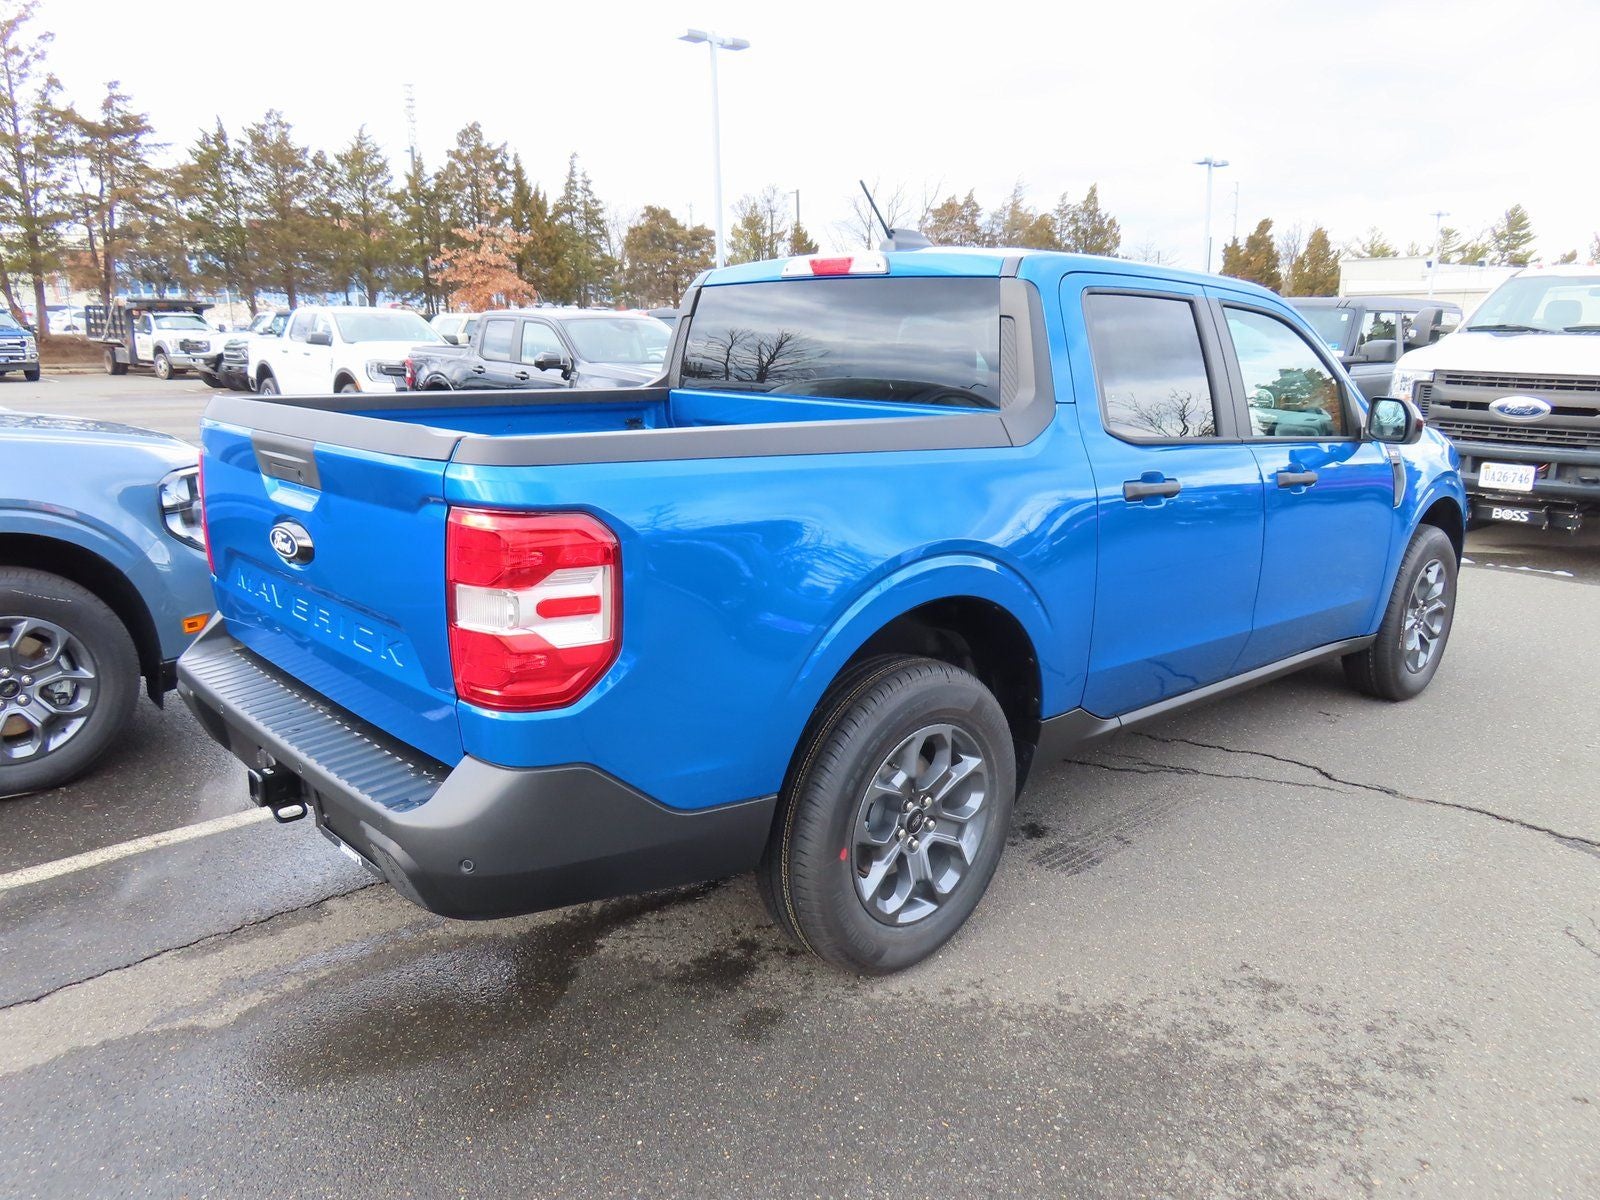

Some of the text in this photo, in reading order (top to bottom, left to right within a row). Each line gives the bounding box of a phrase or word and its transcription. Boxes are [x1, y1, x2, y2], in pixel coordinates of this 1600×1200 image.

[1504, 405, 1534, 416] Ford
[1492, 507, 1529, 521] BOSS
[273, 530, 292, 554] Ford
[237, 567, 404, 667] MAVERICK
